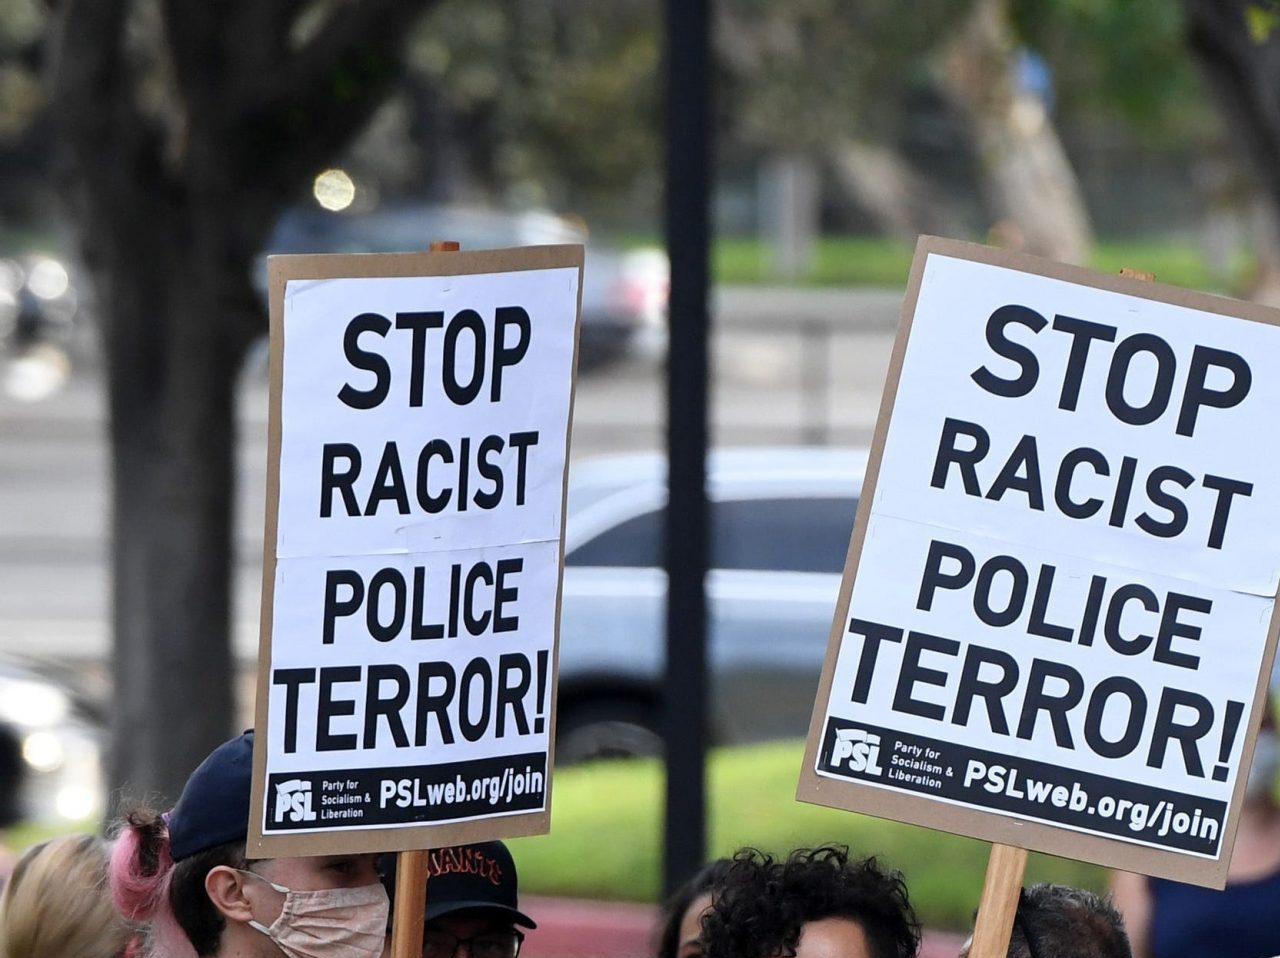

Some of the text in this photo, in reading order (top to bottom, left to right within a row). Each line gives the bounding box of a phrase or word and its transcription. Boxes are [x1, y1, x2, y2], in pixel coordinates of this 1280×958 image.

[337, 306, 531, 410] STOP
[970, 304, 1253, 438] STOP
[319, 430, 539, 519] RACIST
[930, 417, 1254, 550] RACIST
[323, 558, 524, 645] POLICE
[915, 539, 1213, 670] POLICE
[272, 650, 549, 754] TERROR!
[847, 618, 1246, 783] TERROR!
[830, 737, 882, 776] PSL
[888, 768, 941, 788] Liberation
[891, 755, 953, 777] Socialism &
[895, 741, 940, 759] Party for
[275, 792, 317, 822] PSL
[321, 793, 371, 805] Socialism &
[321, 808, 363, 819] Liberation
[323, 780, 359, 792] Party for
[380, 766, 543, 809] PSLweb.org/join
[963, 759, 1219, 841] PSLweb.org/join
